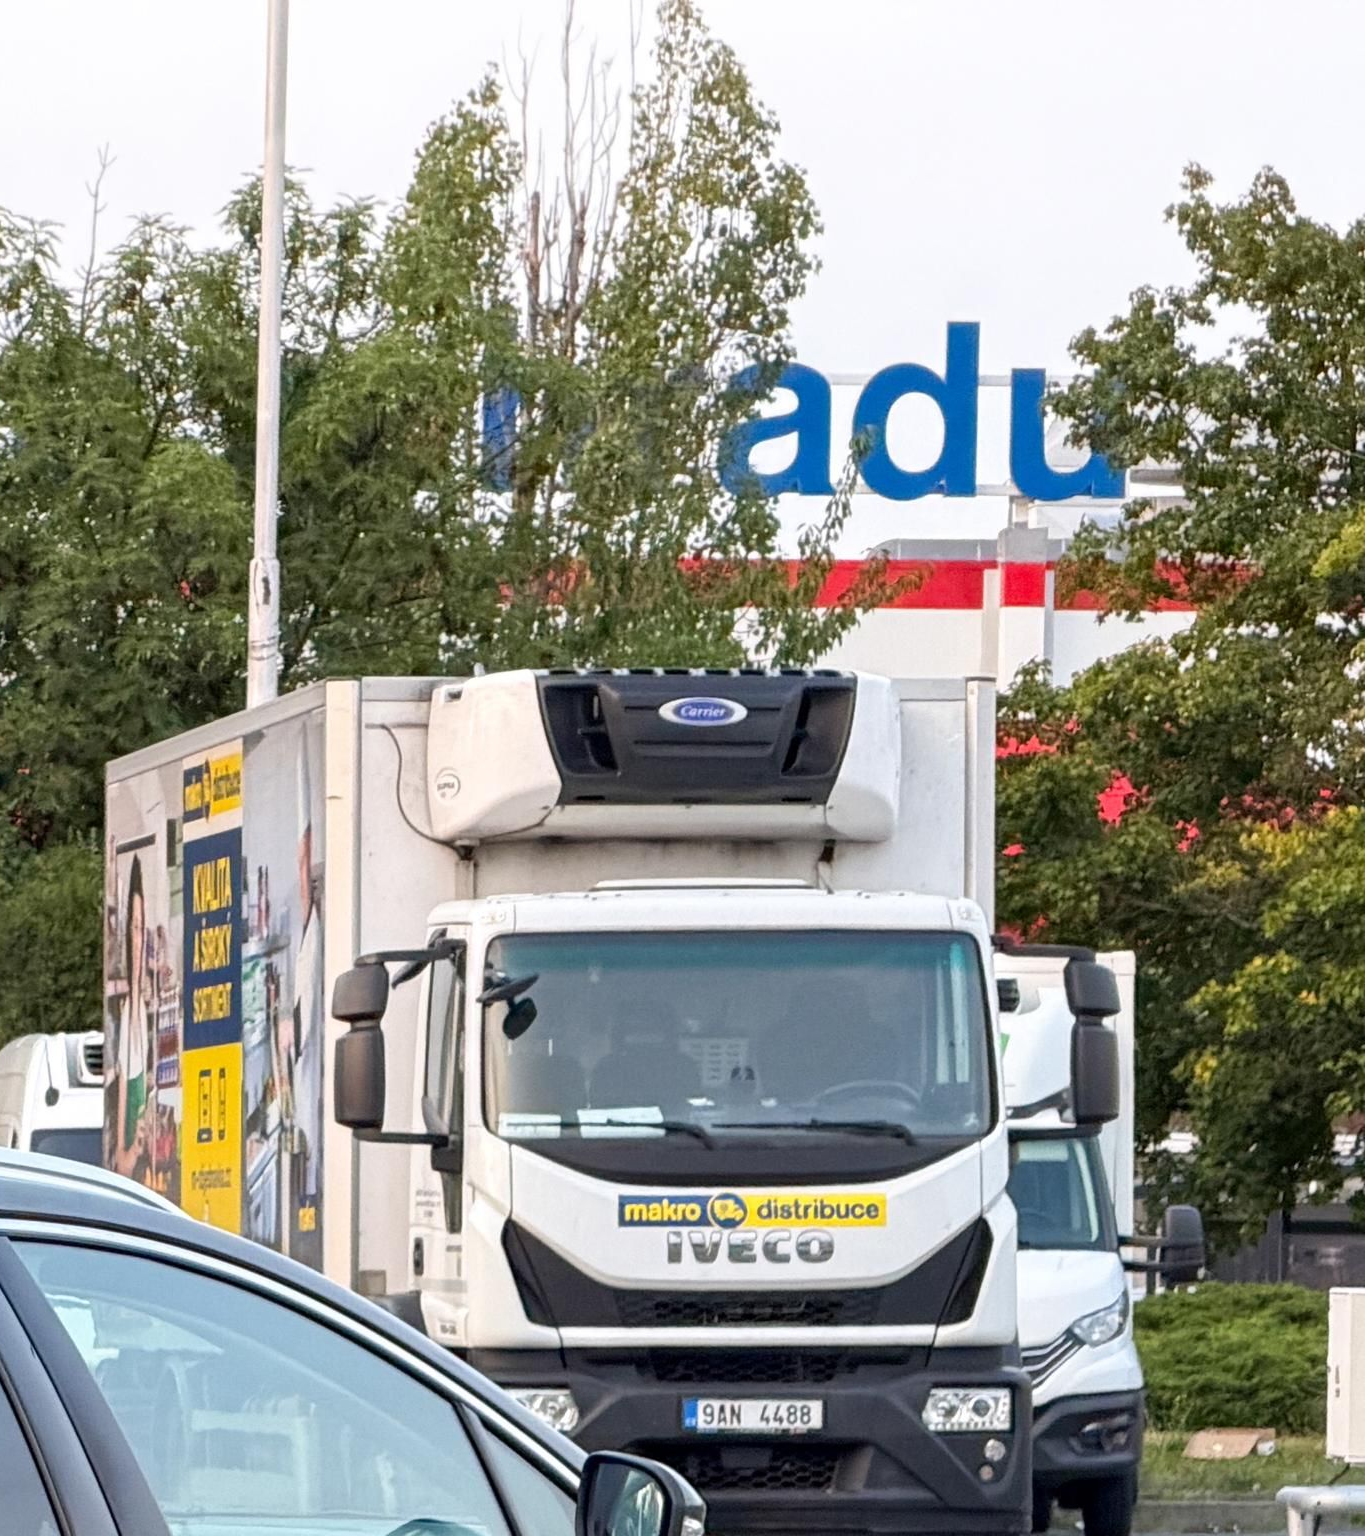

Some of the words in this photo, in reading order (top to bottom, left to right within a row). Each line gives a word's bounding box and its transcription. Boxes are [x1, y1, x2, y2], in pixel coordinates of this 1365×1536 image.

[680, 705, 726, 717] Carrier
[624, 1198, 702, 1222] makro
[756, 1199, 880, 1220] distribuce
[667, 1229, 835, 1264] IVECO
[702, 1403, 742, 1425] 9AN
[759, 1404, 812, 1425] 4488
